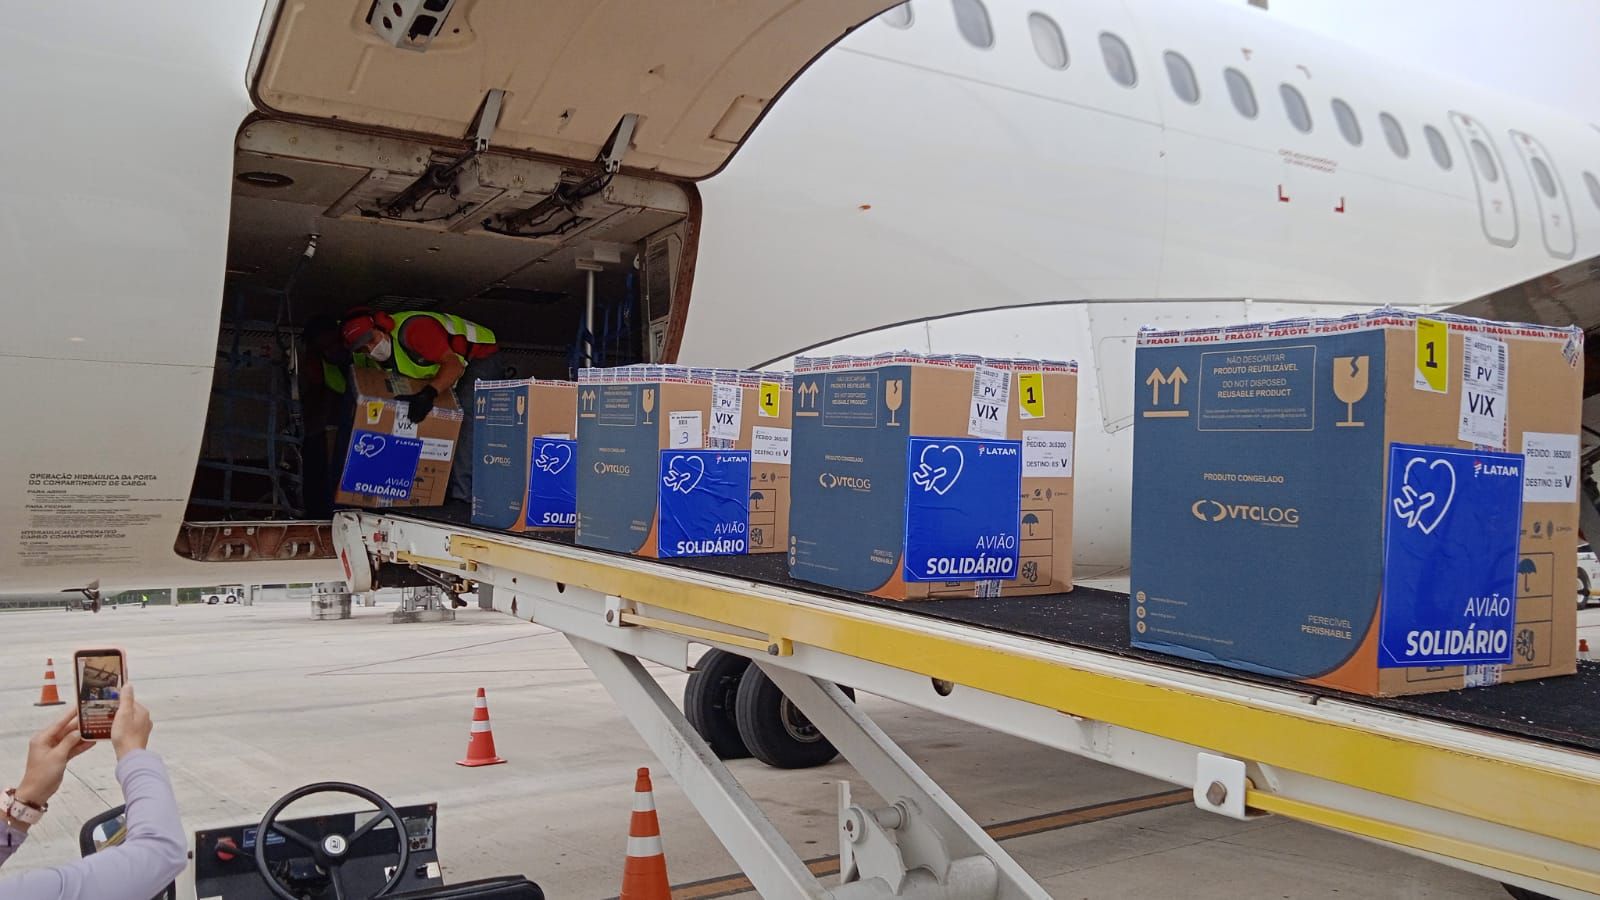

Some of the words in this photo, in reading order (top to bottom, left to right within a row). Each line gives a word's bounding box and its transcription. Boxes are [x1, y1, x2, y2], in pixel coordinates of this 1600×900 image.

[1425, 341, 1438, 368] 1
[1213, 366, 1247, 375] PRODUTO
[1477, 366, 1492, 381] PV
[1250, 378, 1287, 387] DISPOSED
[984, 386, 996, 397] PV
[1026, 386, 1036, 404] 1
[1217, 390, 1255, 398] REUSABLE
[1256, 389, 1292, 397] PRODUCT
[721, 399, 731, 407] PV
[765, 393, 773, 406] 1
[1468, 391, 1495, 418] VIX
[715, 412, 734, 425] VIX
[976, 403, 999, 421] VIX
[397, 422, 413, 430] VIX
[679, 431, 689, 445] 3
[783, 449, 788, 457] V
[986, 447, 1017, 455] LATAM
[1061, 458, 1067, 468] V
[1483, 465, 1519, 477] LATAM
[385, 477, 410, 488] AVIÃO
[836, 476, 872, 489] VTCLOG
[1203, 473, 1237, 481] PRODUTO
[1238, 474, 1284, 483] CONGELADO
[1564, 475, 1572, 488] V
[355, 482, 407, 498] SOLIDÁRIO
[543, 512, 576, 524] SOLID
[1227, 505, 1299, 523] VTCLOG
[714, 521, 745, 534] AVIÃO
[677, 537, 744, 554] SOLIDÁRIO
[976, 533, 1015, 549] AVIÃO
[926, 552, 1013, 574] SOLIDÁRIO
[1464, 593, 1510, 617] AVIÃO
[1301, 624, 1353, 640] PERISHABLE
[1406, 623, 1507, 656] SOLIDÁRIO
